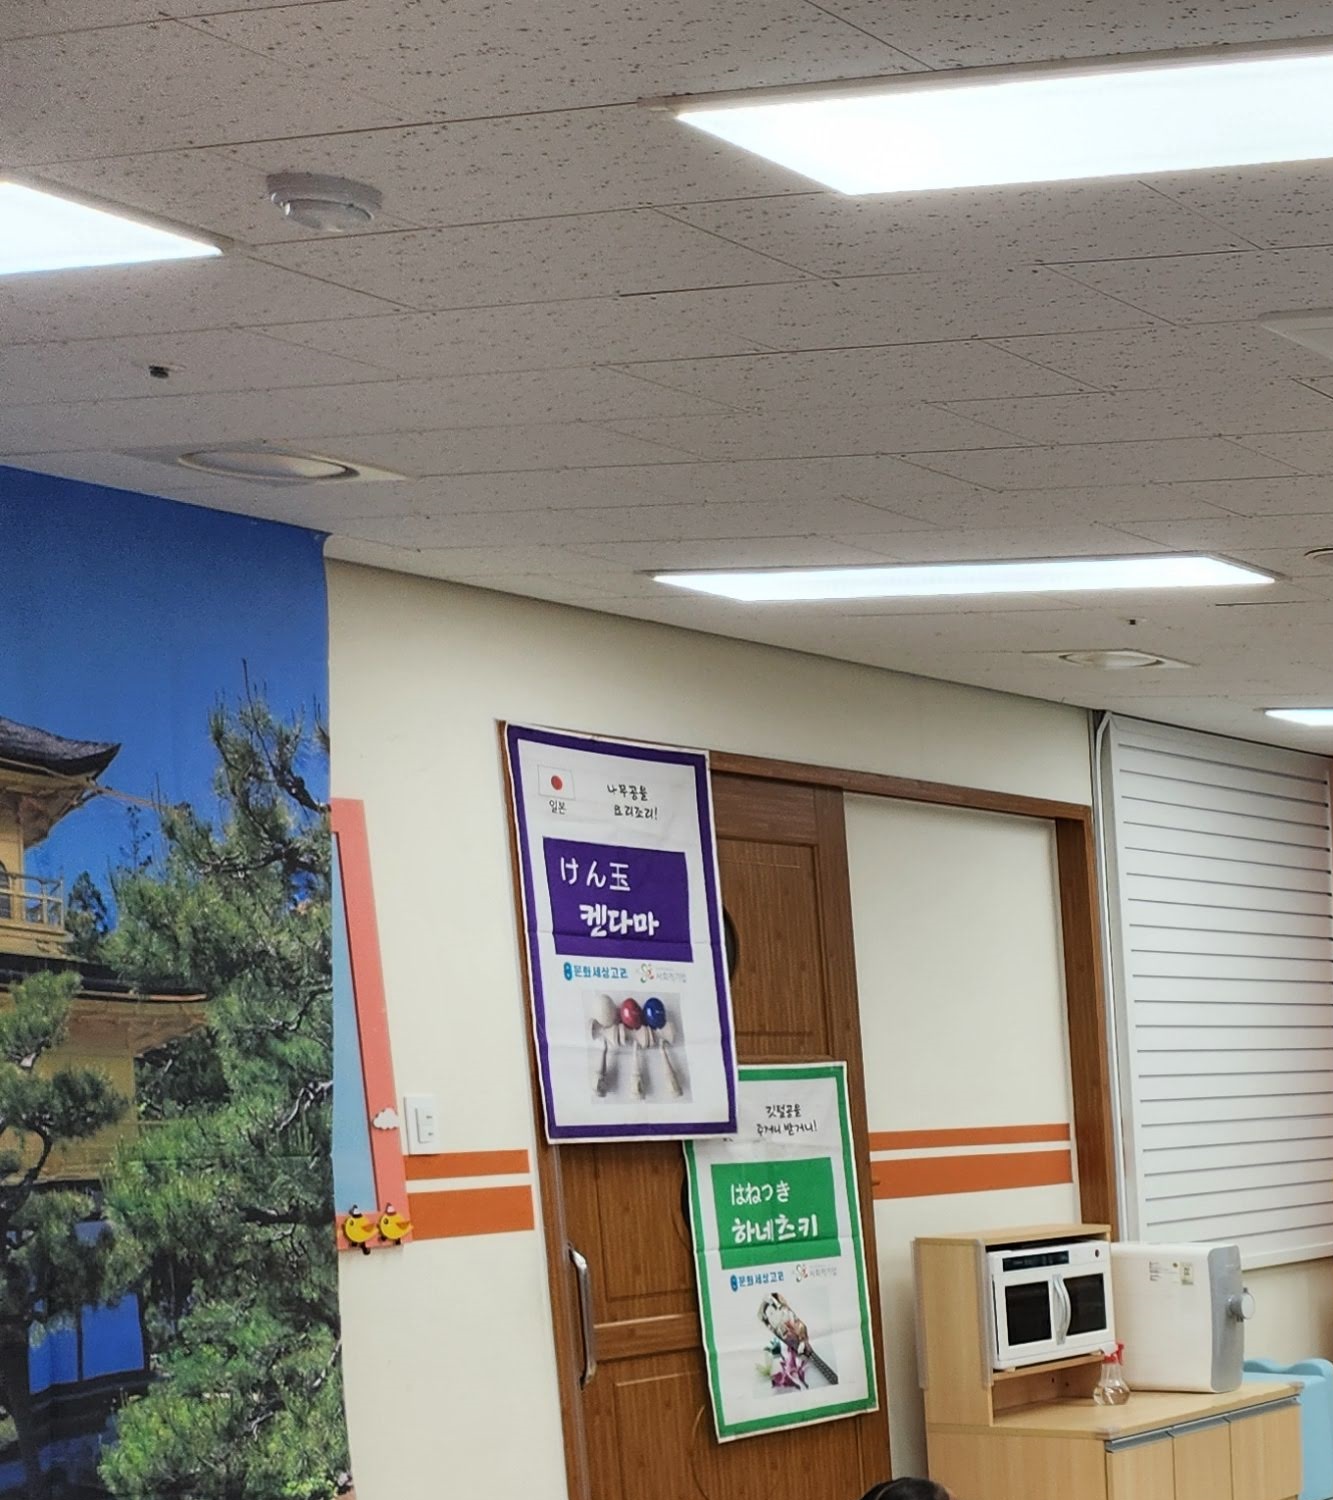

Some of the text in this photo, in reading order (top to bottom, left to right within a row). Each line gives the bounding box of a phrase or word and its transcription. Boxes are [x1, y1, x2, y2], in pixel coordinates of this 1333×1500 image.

[606, 784, 649, 801] 나무공을
[549, 799, 567, 815] 일본
[613, 804, 659, 821] 요리조리!
[560, 856, 632, 892] けん玉
[579, 903, 660, 938] 켄다마
[573, 964, 629, 980] 문화세상고리
[765, 1103, 802, 1119] 깃털공을
[730, 1180, 790, 1206] はねつき
[731, 1213, 819, 1244] 하네츠키
[738, 1270, 785, 1288] 문화세상고리
